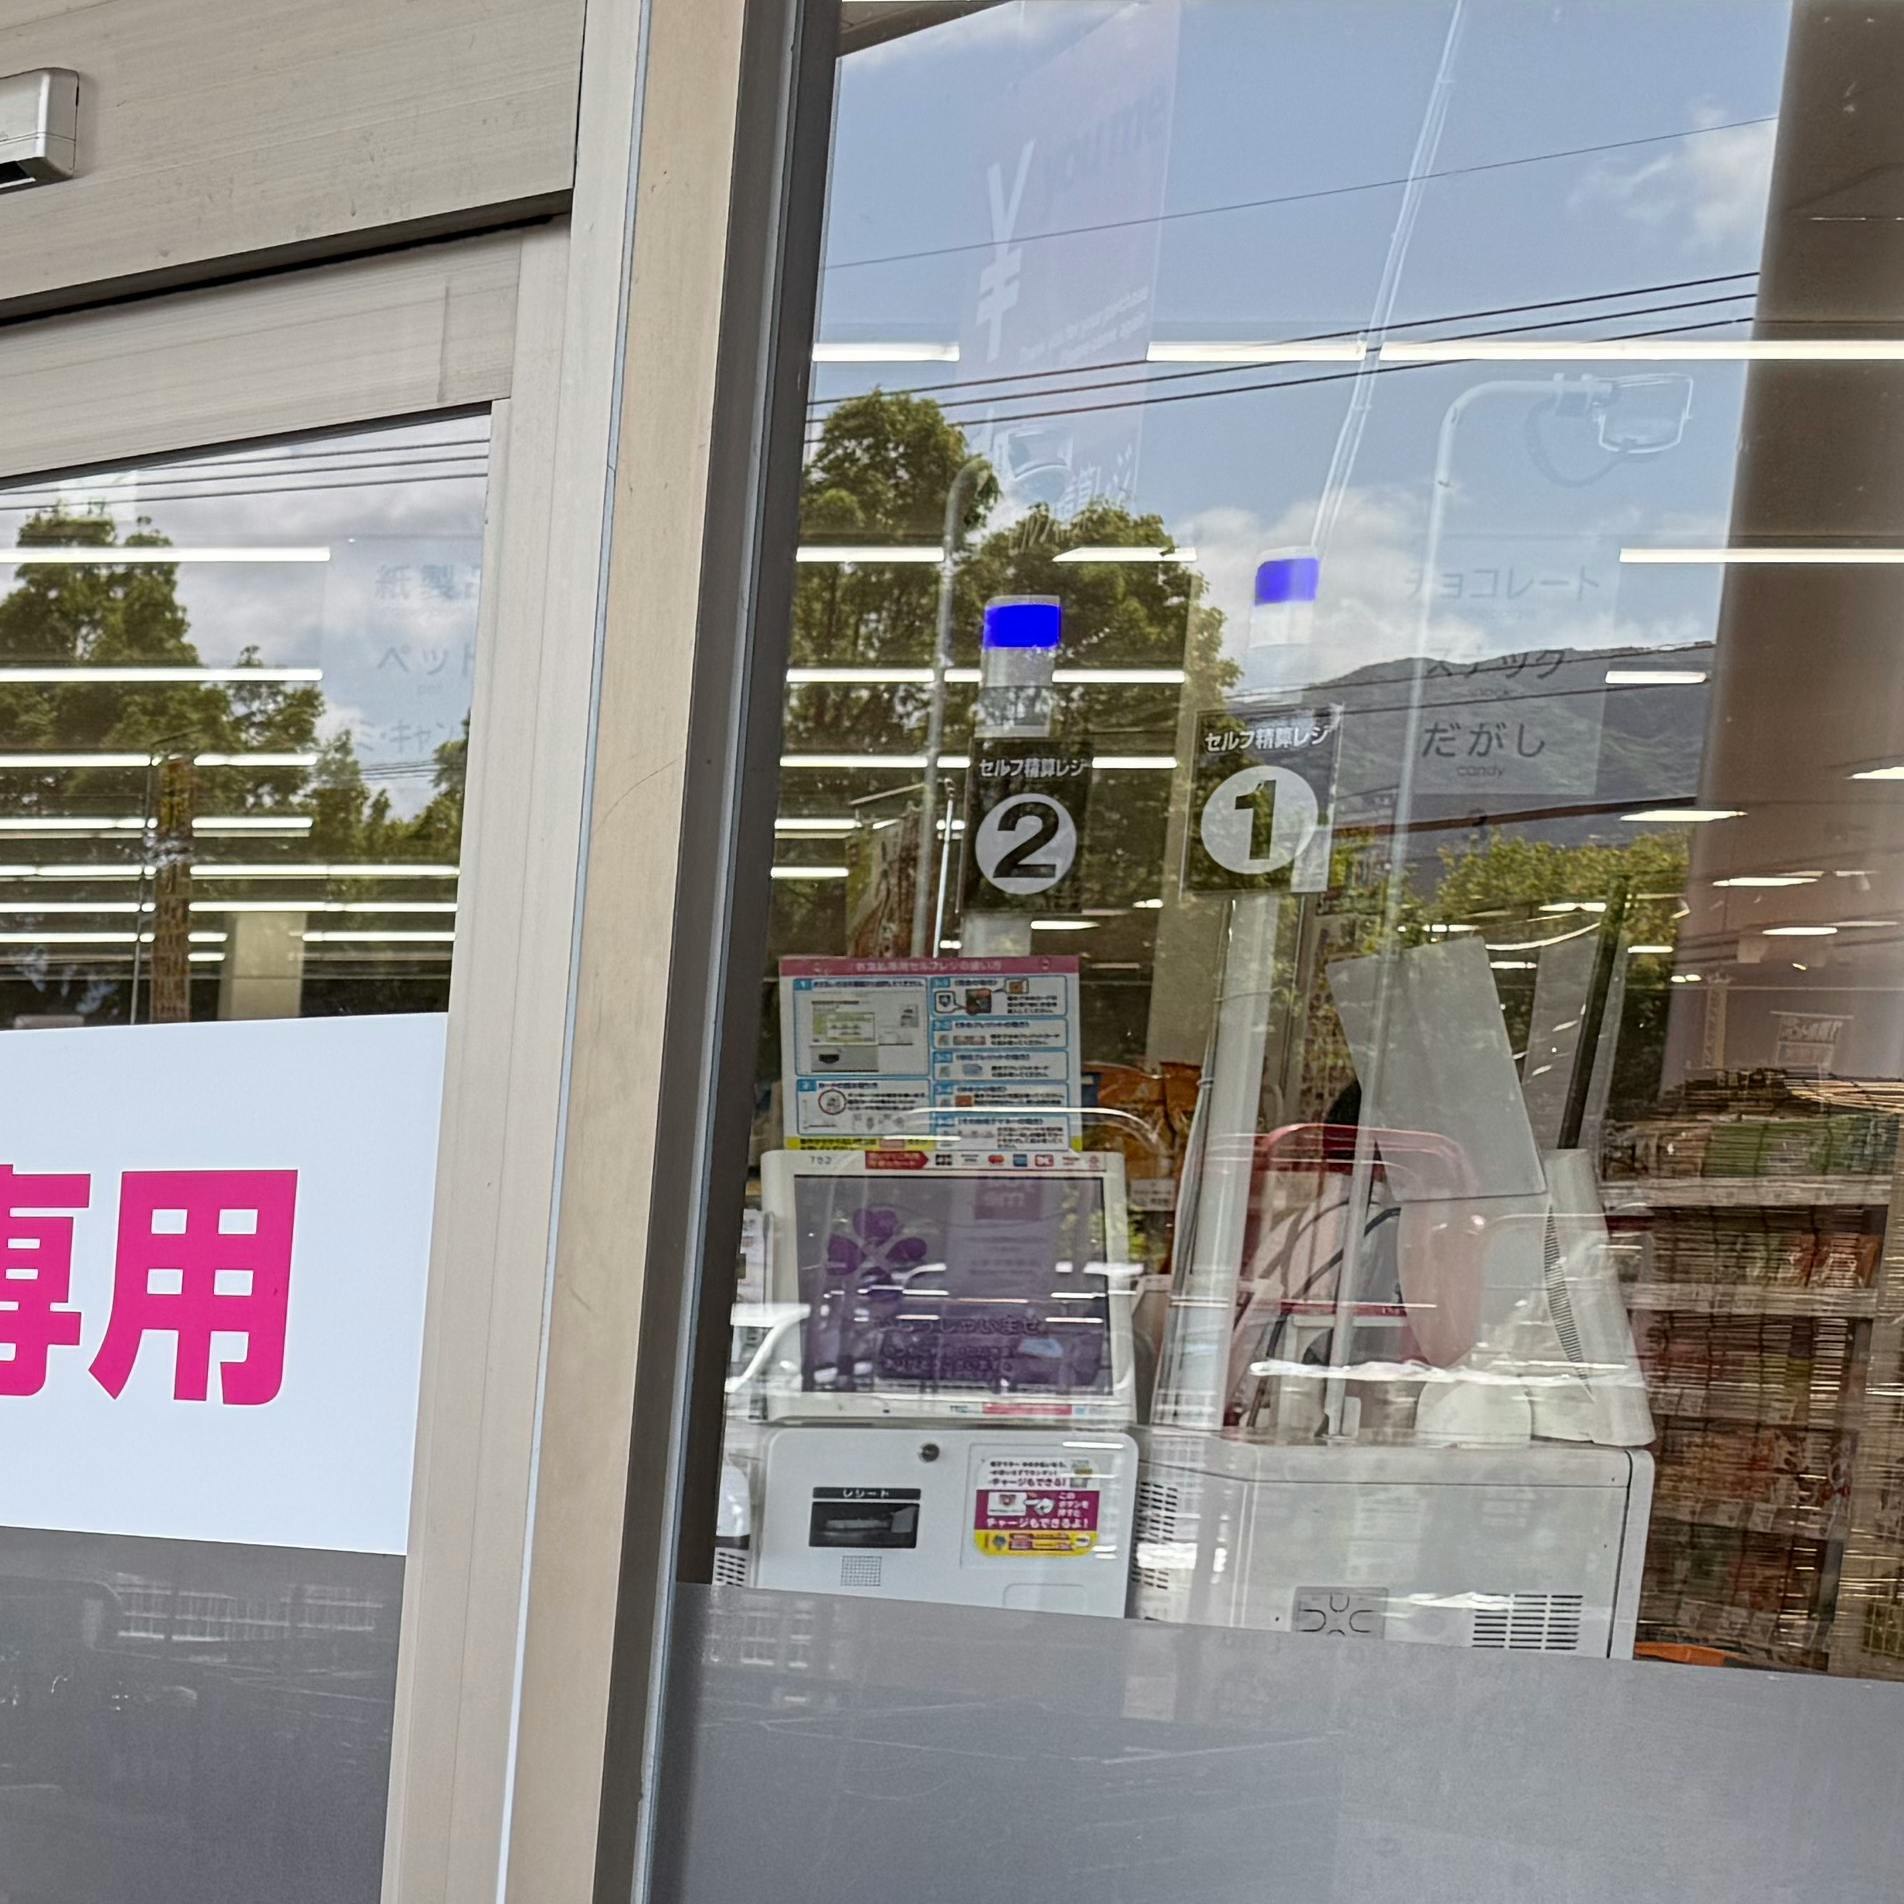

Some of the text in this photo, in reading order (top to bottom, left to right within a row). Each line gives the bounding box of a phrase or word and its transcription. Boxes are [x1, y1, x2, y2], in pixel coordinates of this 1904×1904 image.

[1205, 725, 1331, 753] セルフ精算レジ
[1421, 722, 1546, 759] だがし
[979, 757, 1088, 778] セルフ精算レジ
[1235, 780, 1276, 860] 1
[993, 801, 1057, 879] 2
[843, 1489, 890, 1498] レシート
